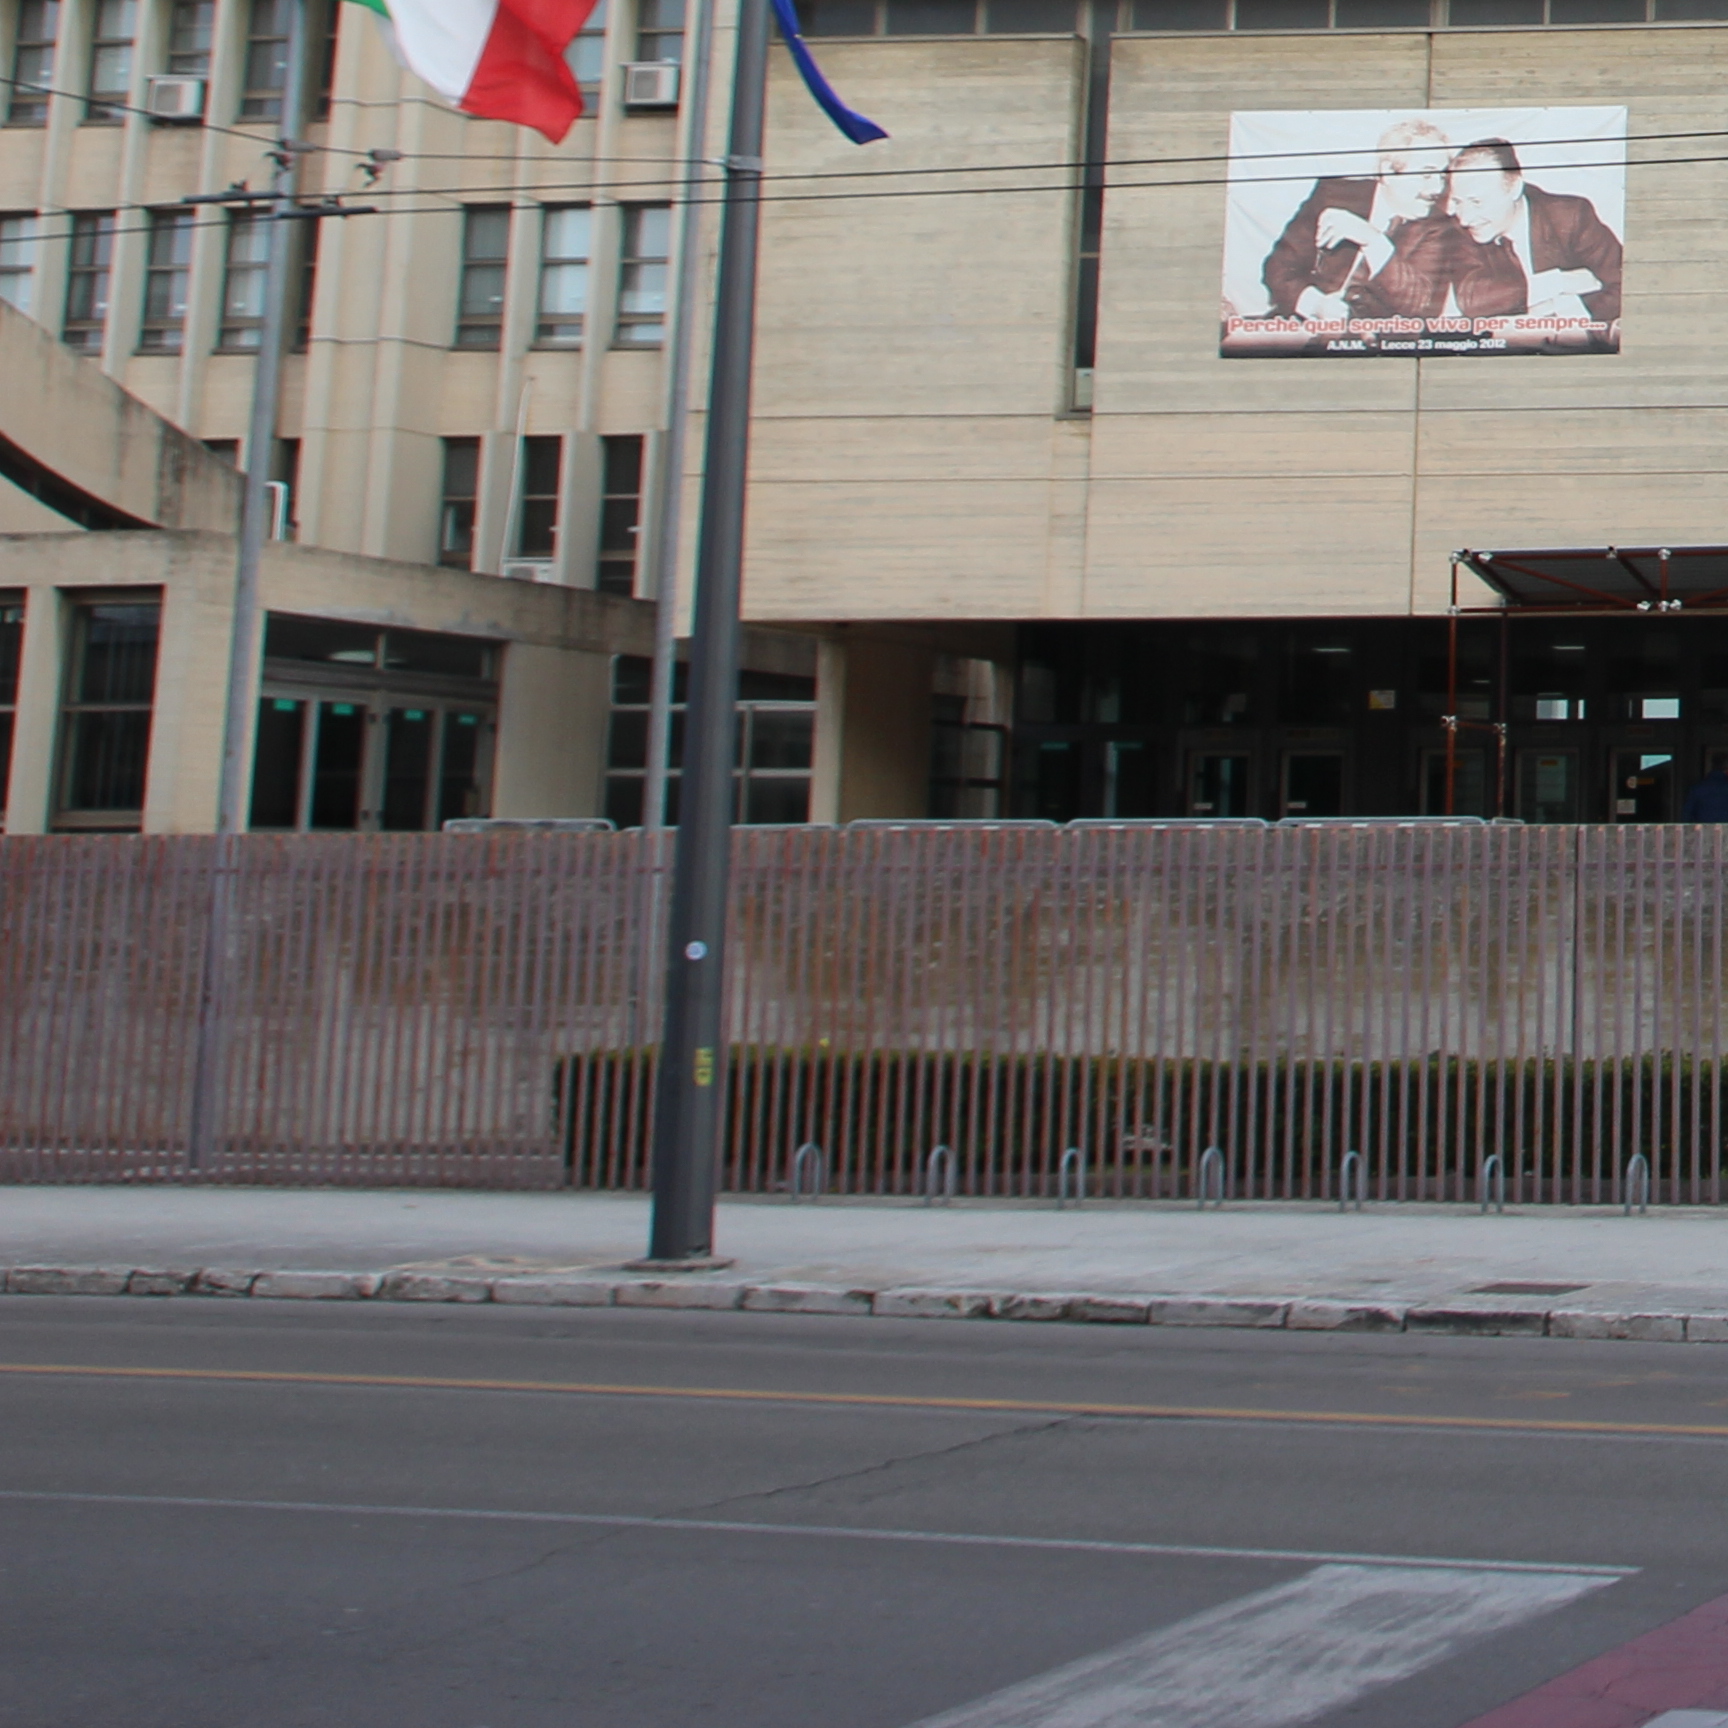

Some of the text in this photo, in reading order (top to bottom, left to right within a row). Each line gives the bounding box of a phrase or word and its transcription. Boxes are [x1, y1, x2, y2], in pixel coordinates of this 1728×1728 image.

[1304, 317, 1347, 335] quel
[1350, 316, 1423, 333] sorriso
[1427, 316, 1470, 333] viva
[1474, 318, 1511, 335] per
[1514, 316, 1606, 332] sempre...
[1381, 339, 1417, 351] Lecce
[1417, 339, 1433, 350] 23
[1434, 338, 1478, 351] maggio
[1479, 338, 1507, 349] 2012
